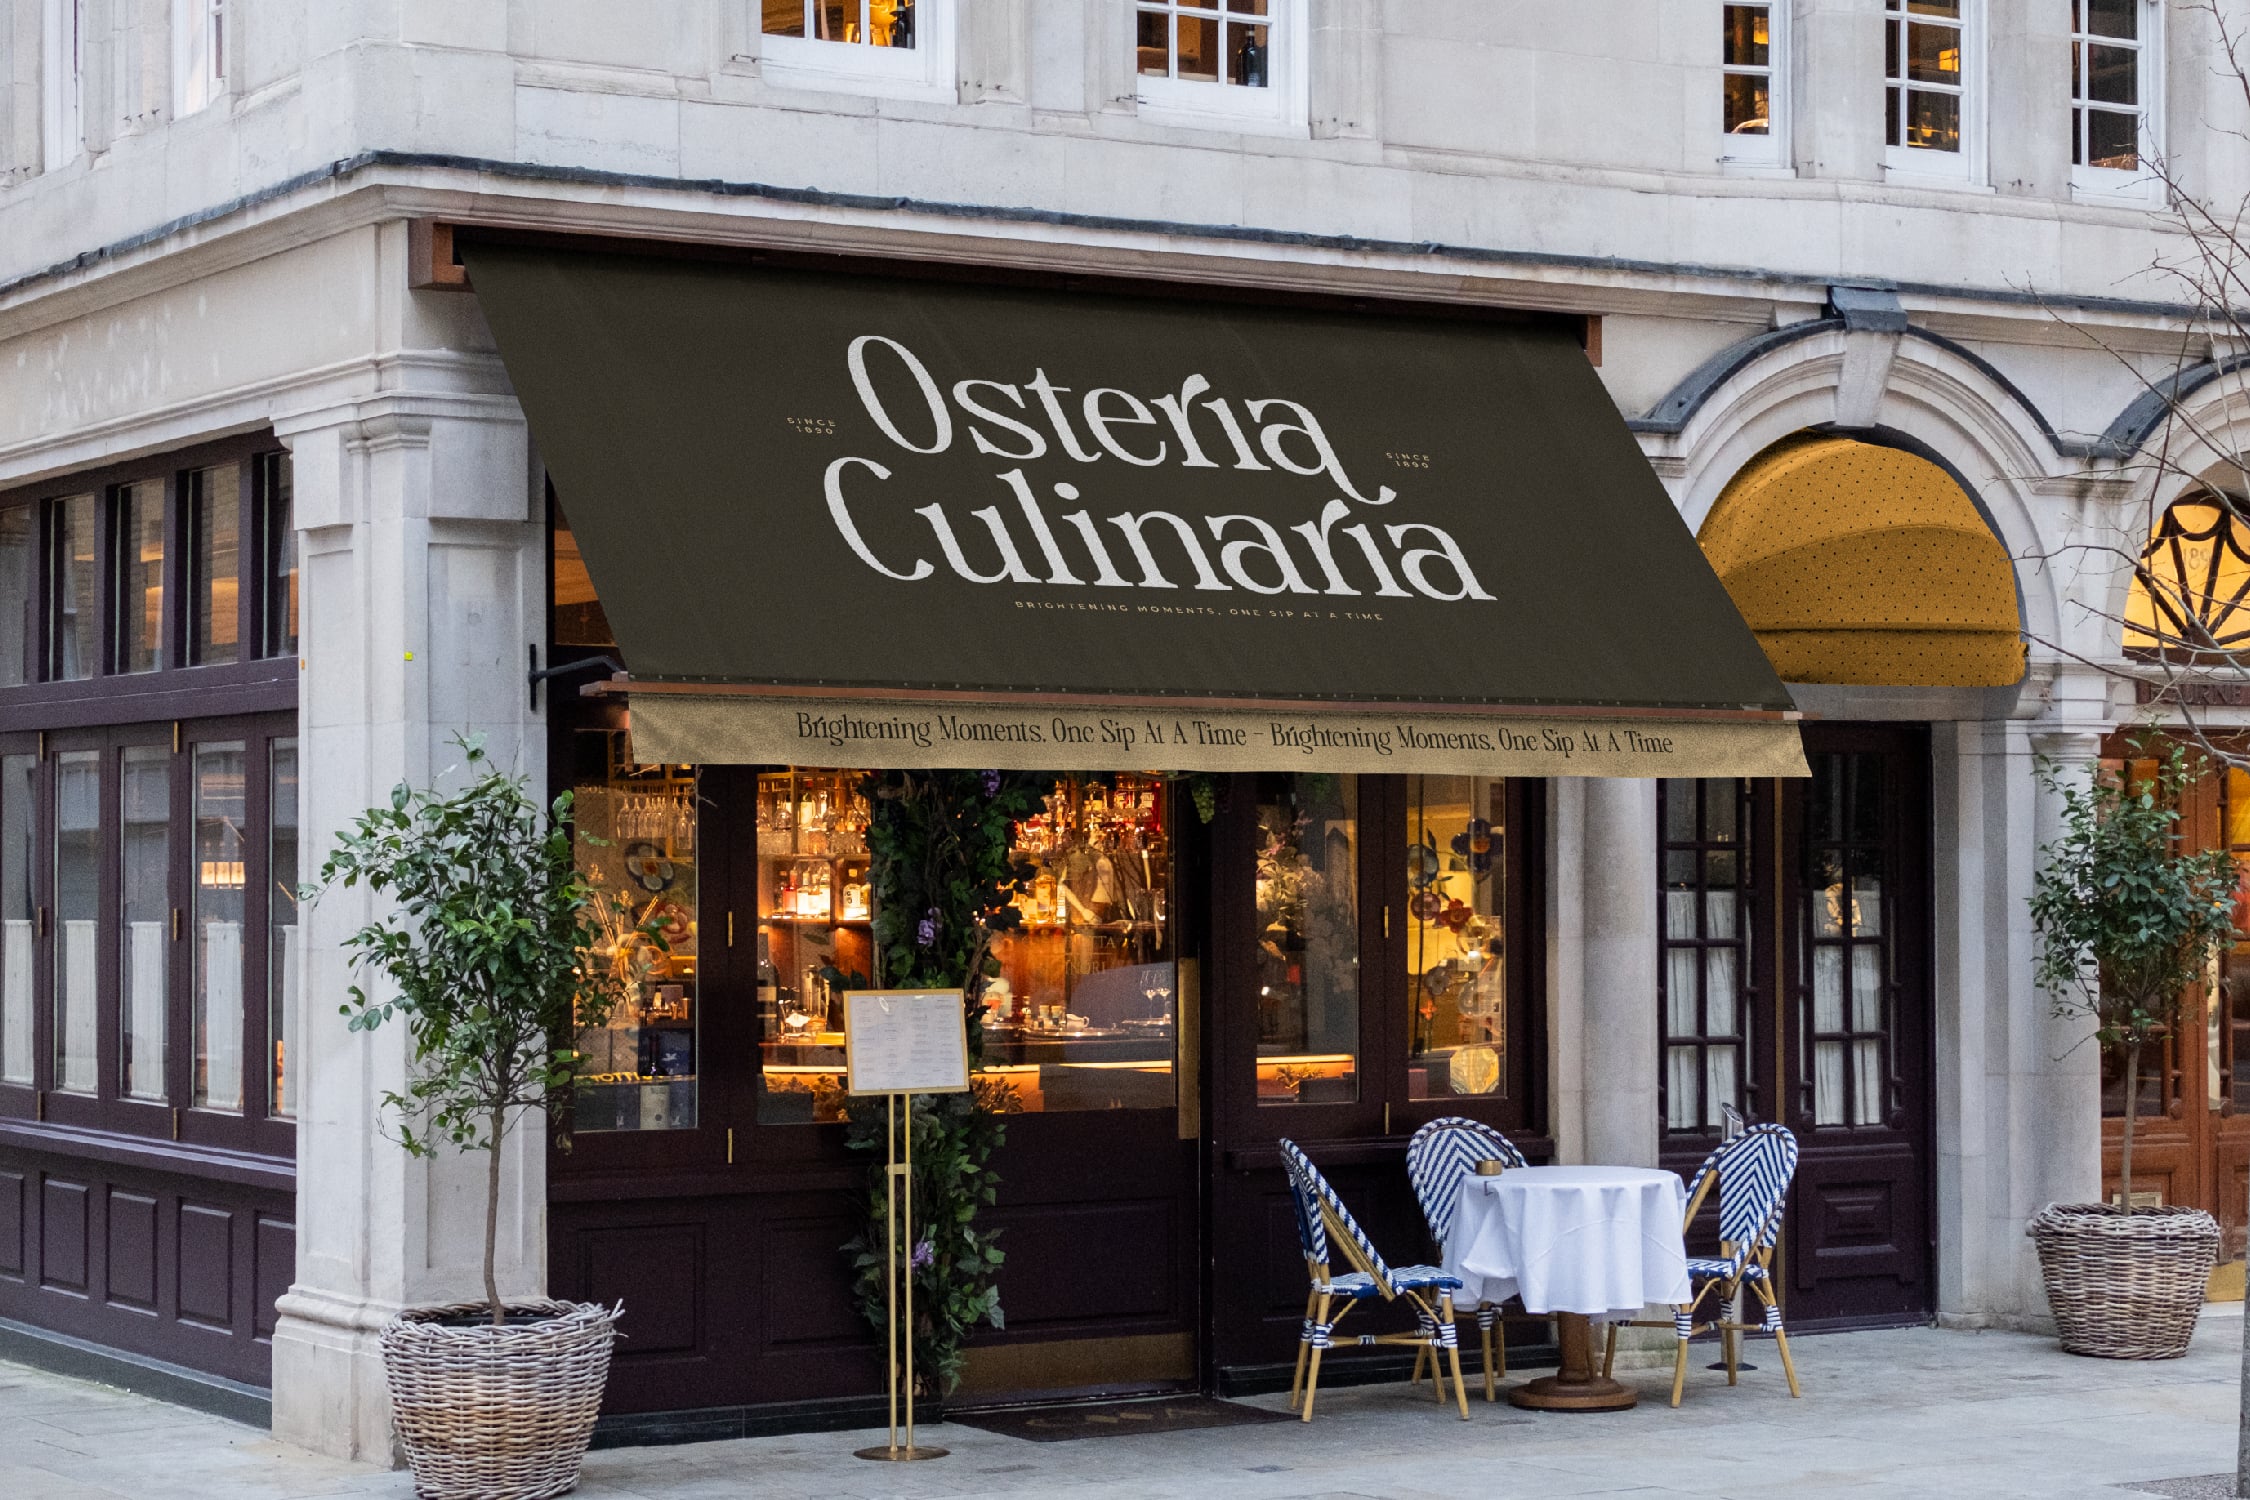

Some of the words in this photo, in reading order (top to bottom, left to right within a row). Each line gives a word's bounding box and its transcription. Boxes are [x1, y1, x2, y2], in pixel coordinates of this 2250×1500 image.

[786, 417, 836, 427] SINCE
[848, 336, 1397, 505] Osteria
[1386, 452, 1430, 461] SINCE
[824, 457, 1497, 600] Culinaria
[1015, 601, 1129, 612] BRIGHTENING
[1230, 608, 1261, 617] ONE
[1269, 610, 1294, 618] SIP
[1344, 612, 1383, 621] TIME
[797, 713, 932, 748] Brightening
[1052, 718, 1095, 743] One
[1100, 718, 1136, 751] Sip
[1144, 720, 1165, 744] At
[1173, 720, 1188, 744] A
[1193, 721, 1247, 746] Time
[1270, 722, 1393, 755] Brightening
[1498, 728, 1538, 751] One
[1542, 729, 1575, 758] Sip
[1582, 730, 1602, 751] At
[1608, 730, 1621, 751] A
[1624, 731, 1674, 753] Time
